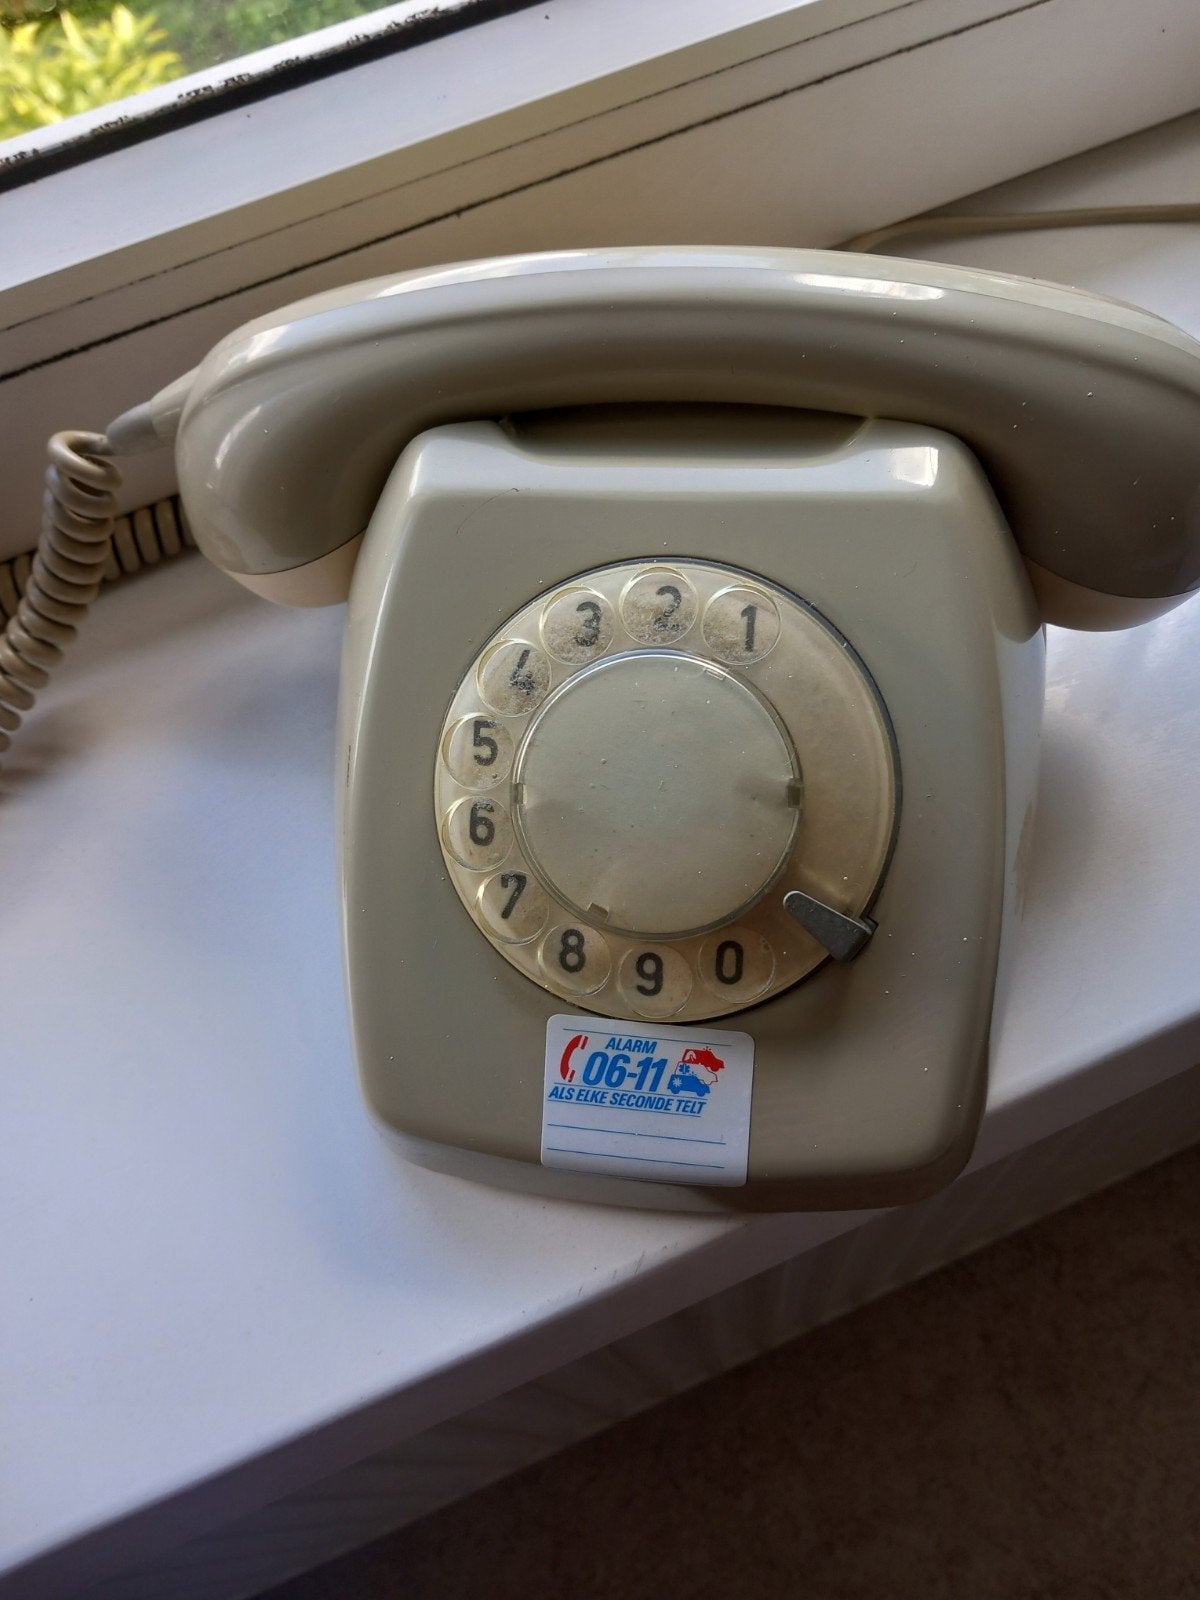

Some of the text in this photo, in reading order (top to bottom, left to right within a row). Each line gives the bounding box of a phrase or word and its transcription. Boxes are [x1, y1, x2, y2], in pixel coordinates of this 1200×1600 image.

[574, 600, 602, 648] 3
[655, 584, 682, 632] 2
[740, 602, 758, 652] 1
[471, 719, 499, 766] 5
[468, 802, 496, 847] 6
[500, 873, 528, 919] 7
[558, 928, 586, 973] 8
[715, 940, 744, 985] 0
[635, 951, 664, 996] 9
[605, 1036, 658, 1055] ALARM
[581, 1051, 668, 1093] 06-11
[548, 1085, 706, 1115] ALS ELKE SECONDE TELT
